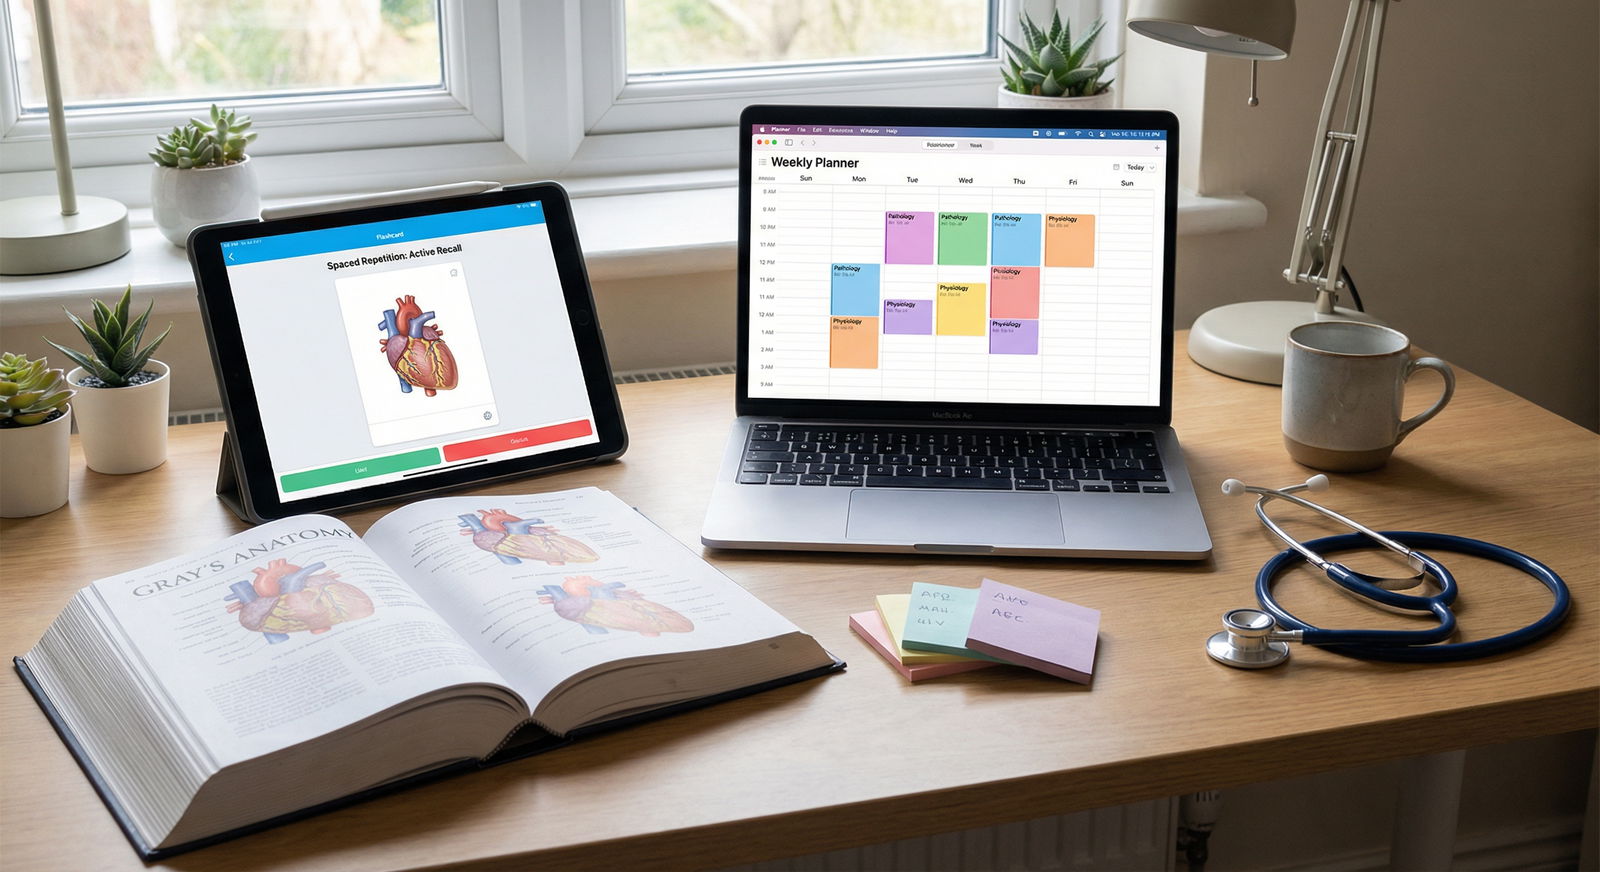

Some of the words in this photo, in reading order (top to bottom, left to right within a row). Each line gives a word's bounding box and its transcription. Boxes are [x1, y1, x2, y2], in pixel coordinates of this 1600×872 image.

[772, 156, 812, 169] Weekly
[816, 157, 859, 168] Planner
[327, 258, 360, 271] Spaced
[361, 252, 408, 266] Repetition:
[409, 248, 436, 259] Active
[436, 244, 462, 254] Recall
[132, 560, 225, 596] GRAY'S
[234, 528, 354, 564] ANATOMY
